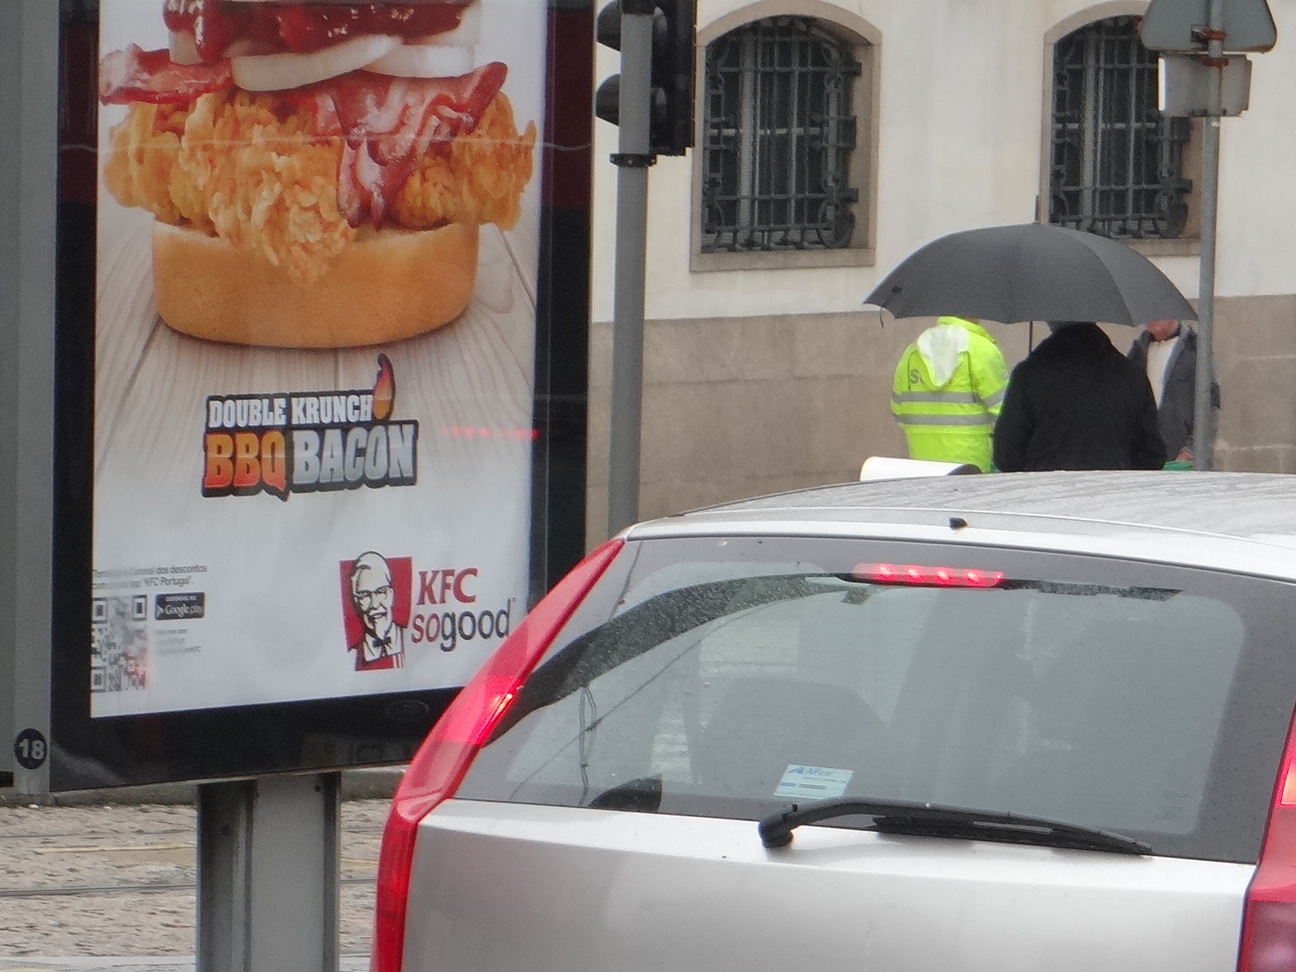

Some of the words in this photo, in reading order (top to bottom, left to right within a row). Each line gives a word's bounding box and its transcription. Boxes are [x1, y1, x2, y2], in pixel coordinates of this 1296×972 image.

[208, 397, 287, 428] DOUBLE
[290, 394, 374, 425] KRUNCH
[204, 429, 287, 492] BBQ
[292, 423, 416, 485] BACON
[170, 563, 208, 575] descontos
[416, 567, 479, 606] KFC
[19, 738, 45, 760] 18
